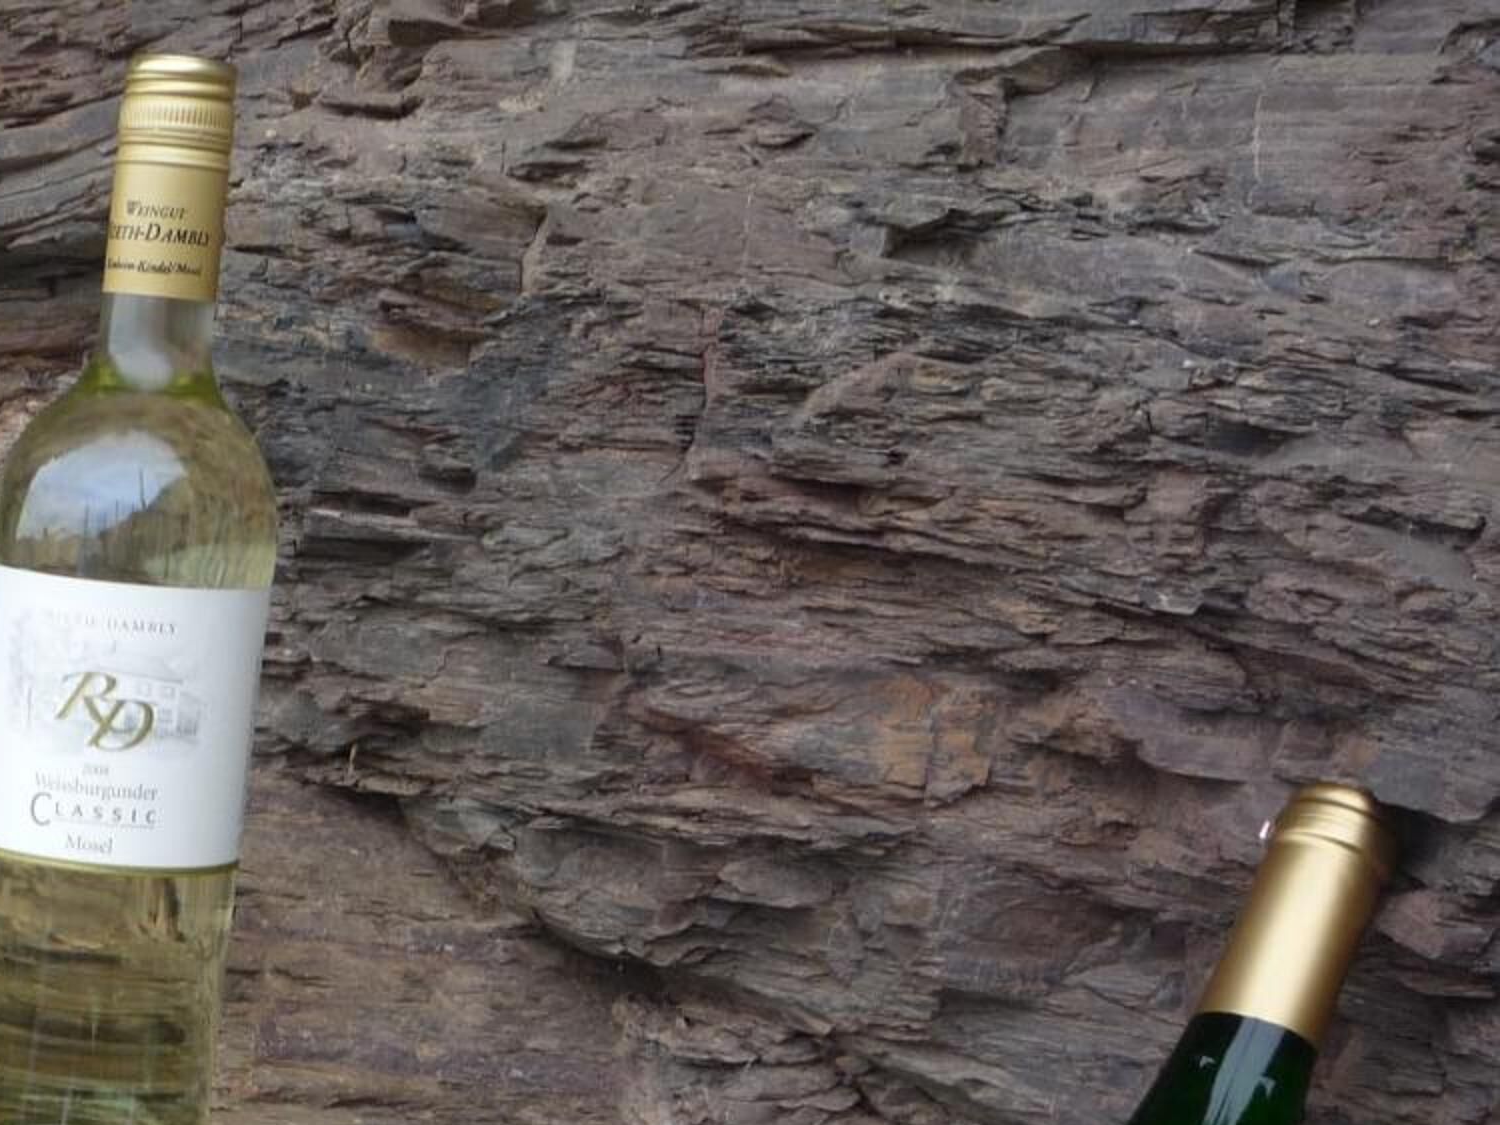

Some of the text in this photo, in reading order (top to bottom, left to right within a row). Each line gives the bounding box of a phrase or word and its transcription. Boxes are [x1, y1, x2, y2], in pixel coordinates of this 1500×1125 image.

[56, 671, 155, 752] RD
[29, 791, 157, 828] CLASSIC
[66, 832, 113, 855] Mosel
